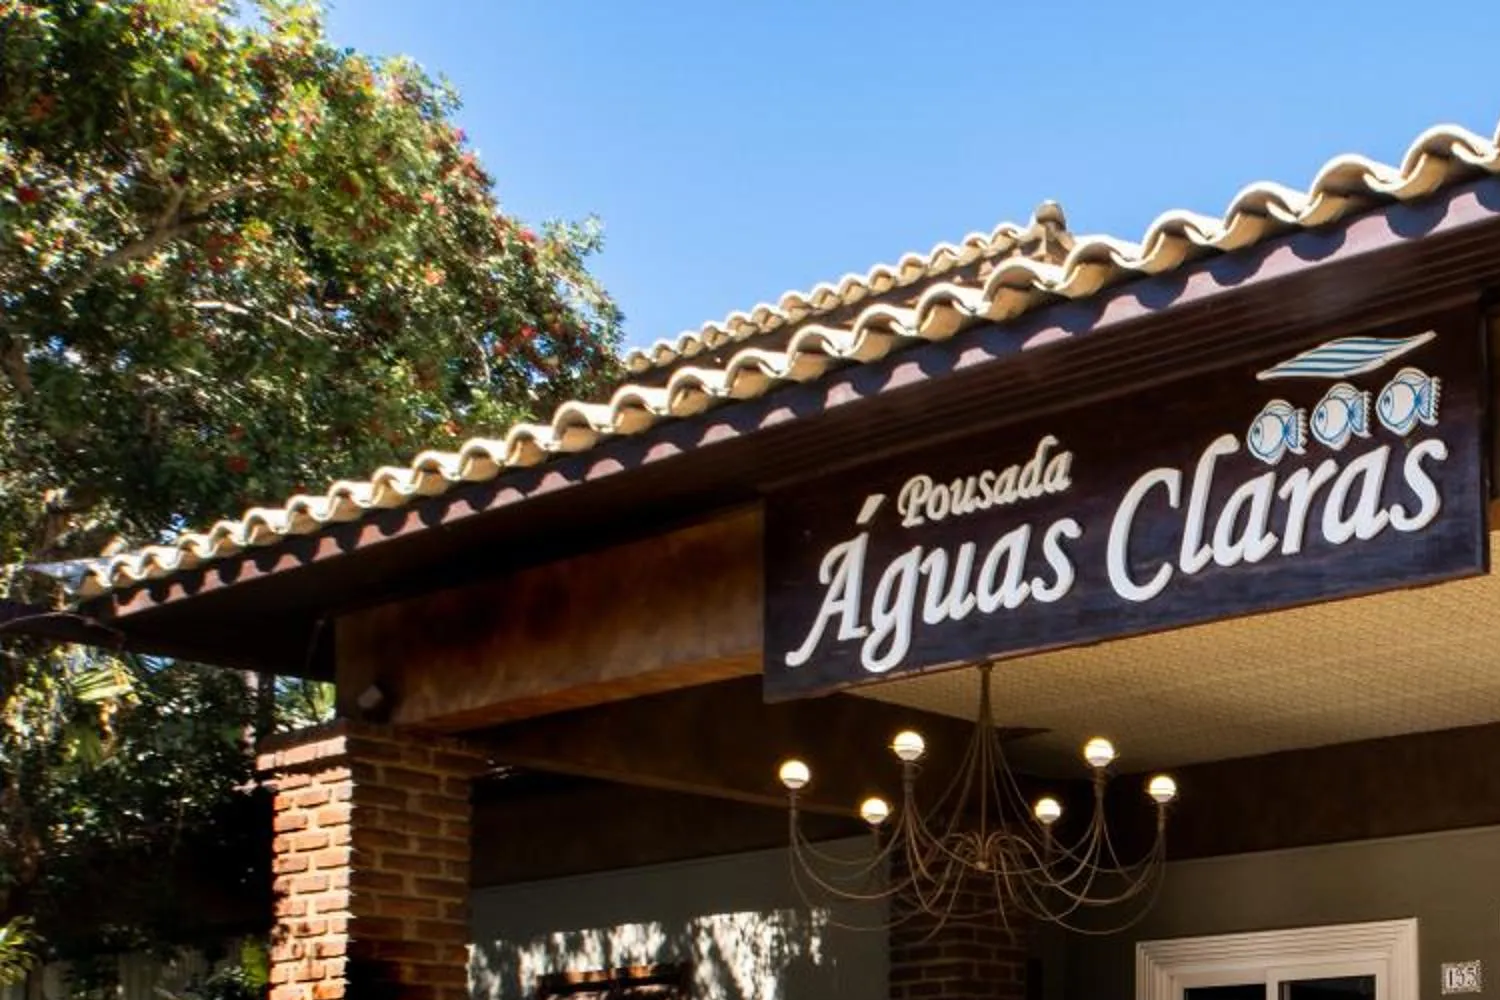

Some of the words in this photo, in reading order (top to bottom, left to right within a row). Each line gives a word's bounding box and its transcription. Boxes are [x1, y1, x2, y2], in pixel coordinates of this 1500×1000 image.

[786, 494, 1082, 673] Águas
[1107, 434, 1448, 602] Claras
[899, 435, 1074, 526] Pousada
